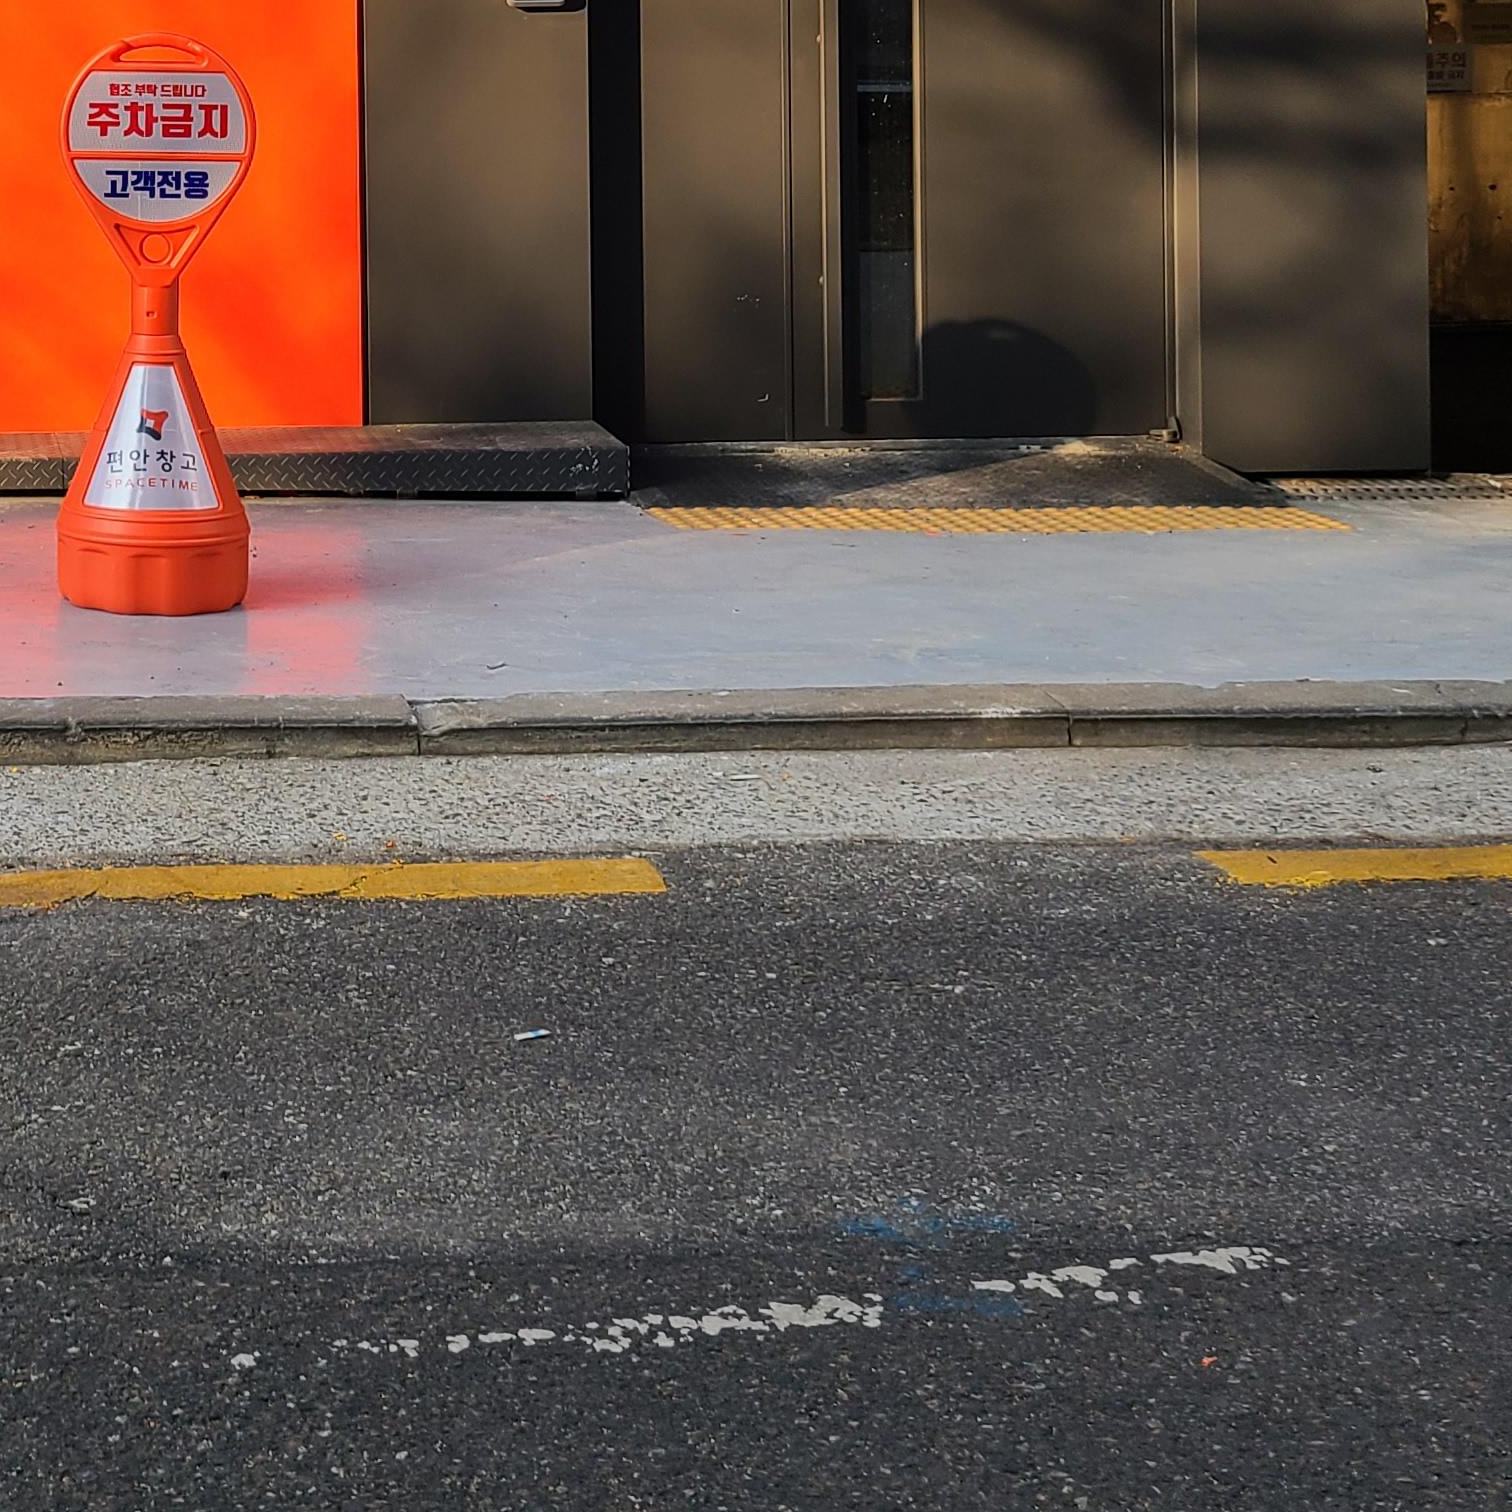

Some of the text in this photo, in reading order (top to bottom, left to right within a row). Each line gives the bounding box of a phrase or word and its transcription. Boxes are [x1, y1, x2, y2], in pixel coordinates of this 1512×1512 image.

[109, 83, 207, 97] 협조 부탁 드립니다
[87, 101, 229, 139] 주차금지
[104, 170, 210, 199] 고객전용
[106, 449, 198, 473] 편안창고
[105, 477, 199, 491] SPACETIME
